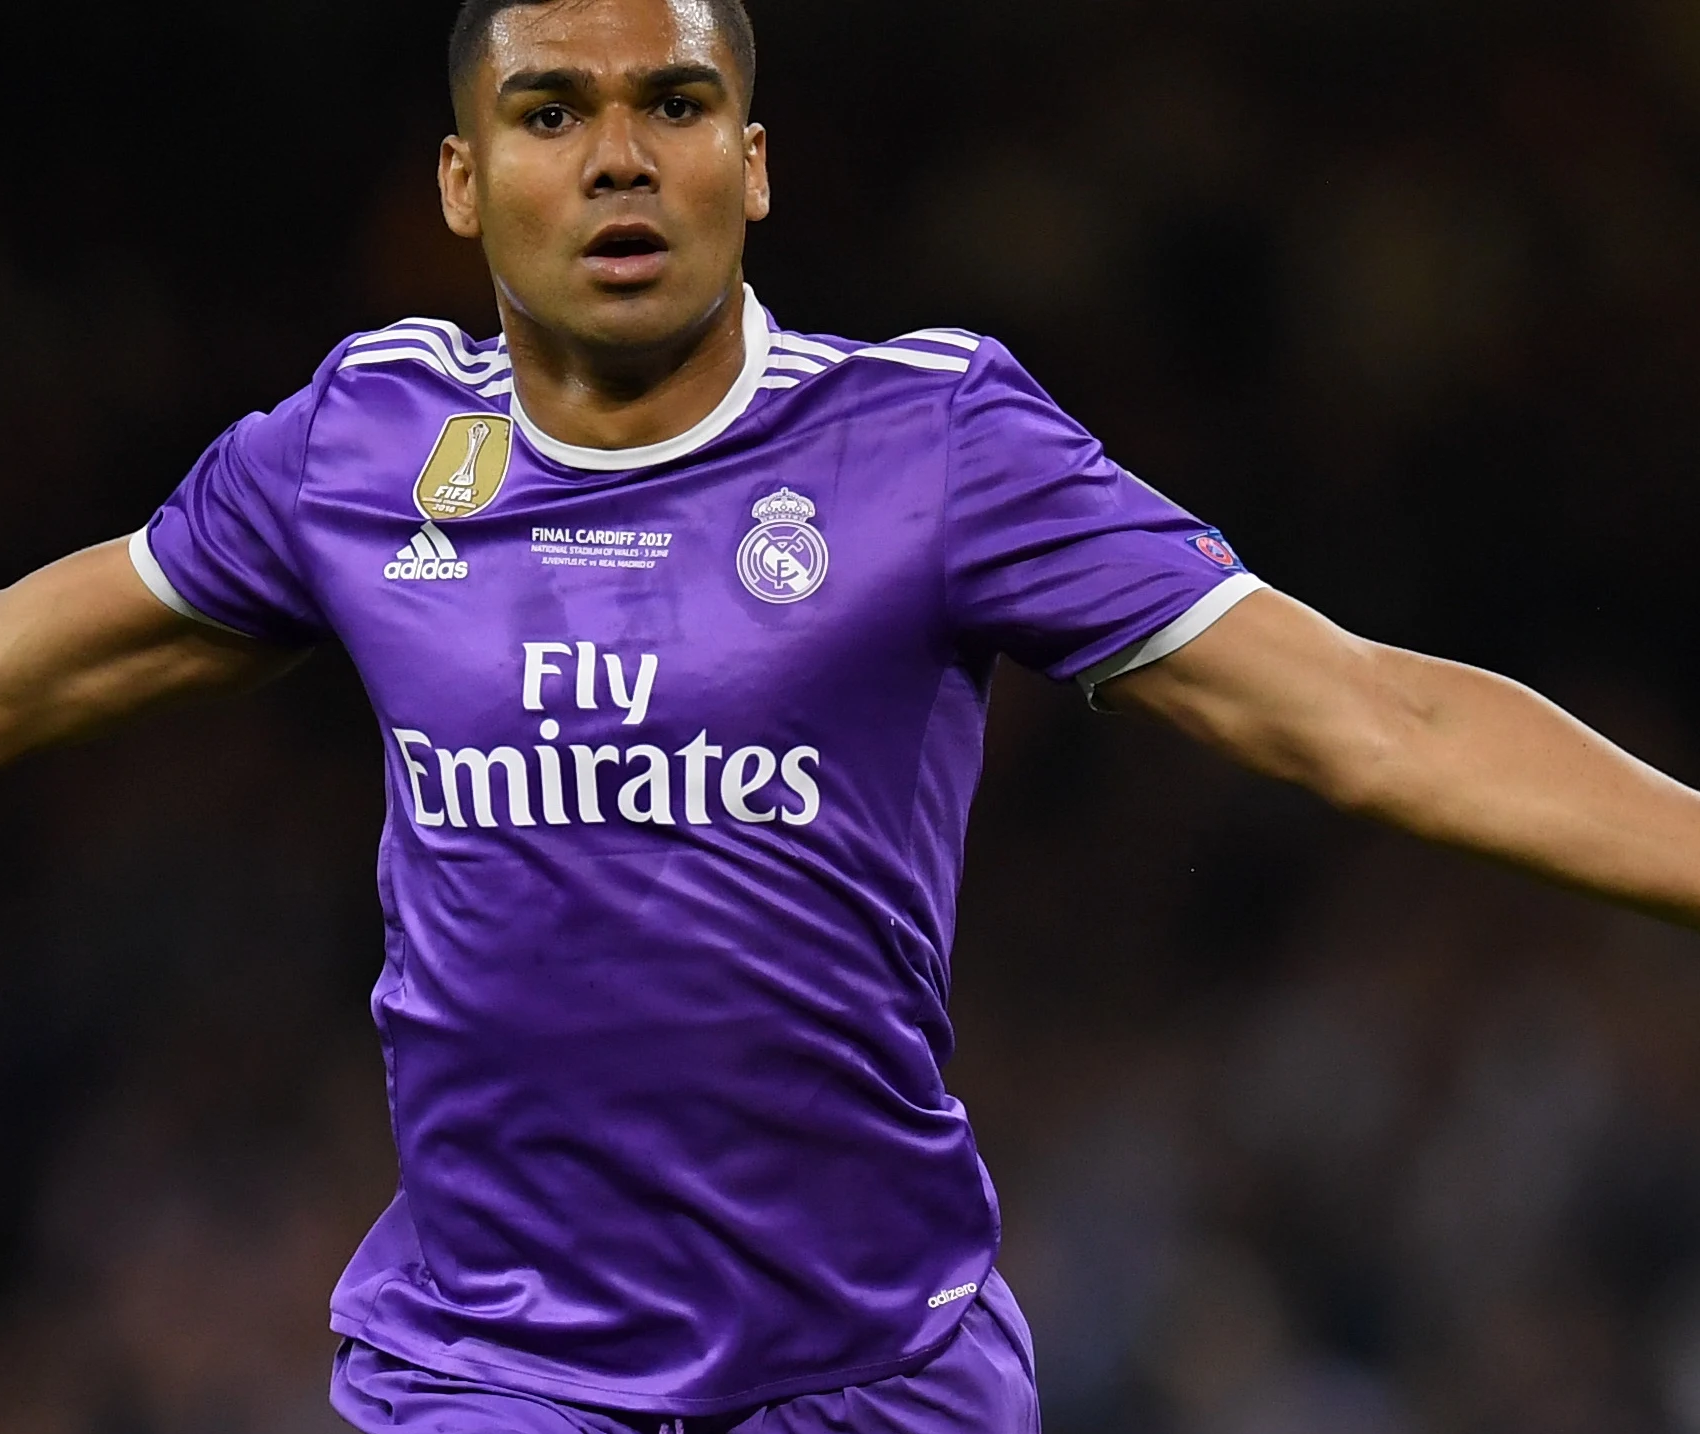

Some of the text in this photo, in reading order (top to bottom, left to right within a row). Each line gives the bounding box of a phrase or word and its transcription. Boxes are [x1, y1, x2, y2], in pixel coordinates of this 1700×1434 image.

[434, 486, 473, 502] FIFA
[531, 527, 673, 547] FINAL CARDIFF 2017
[383, 557, 468, 580] adidas
[522, 641, 658, 724] Fly
[392, 719, 820, 828] Emirates
[927, 1282, 977, 1308] adizero
